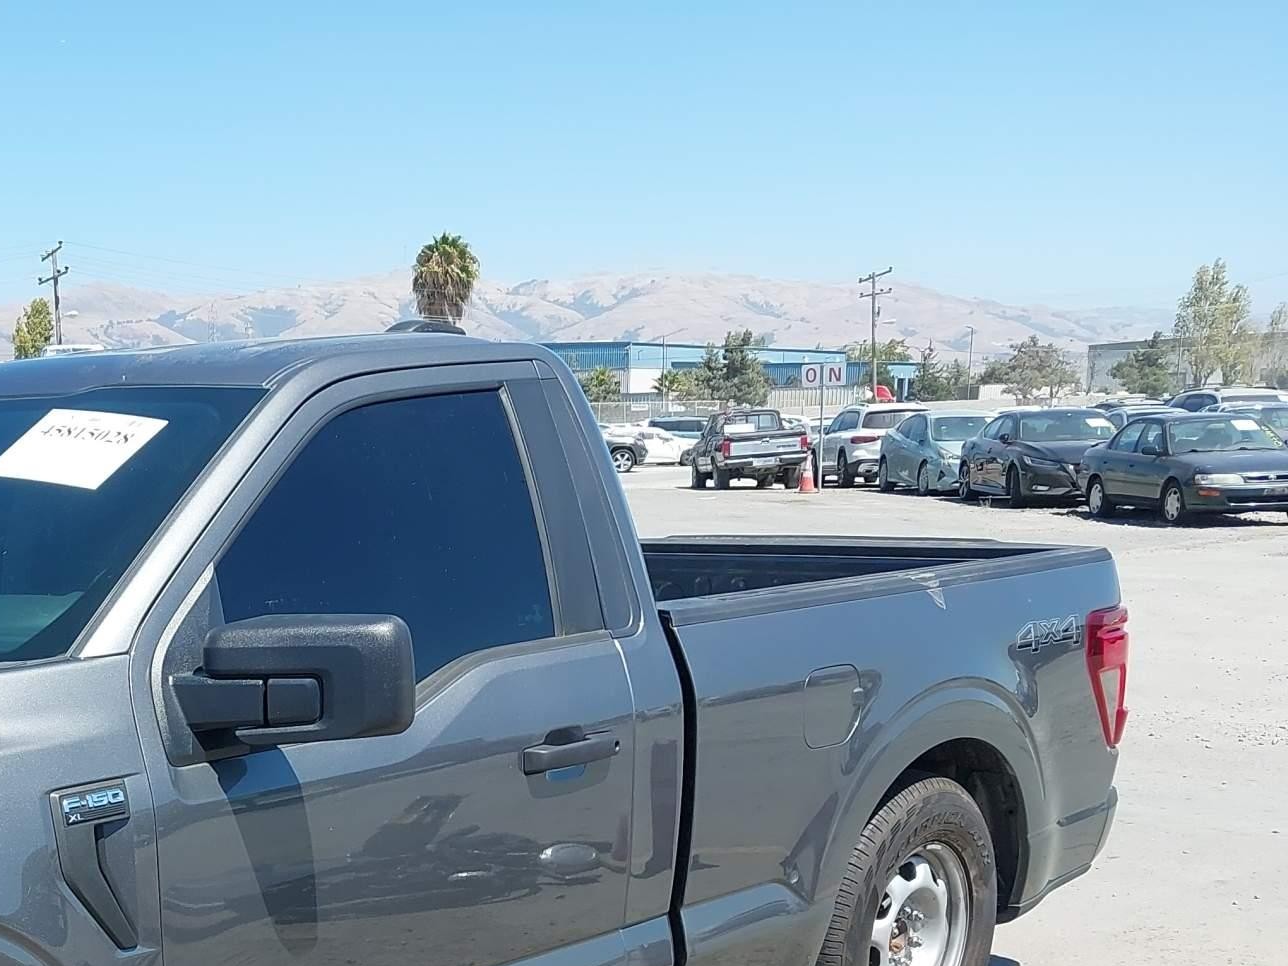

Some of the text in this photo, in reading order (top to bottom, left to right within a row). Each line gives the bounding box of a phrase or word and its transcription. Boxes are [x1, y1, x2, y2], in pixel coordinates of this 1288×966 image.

[40, 424, 136, 445] 45815028
[62, 787, 125, 813] F-150
[68, 813, 85, 823] XL
